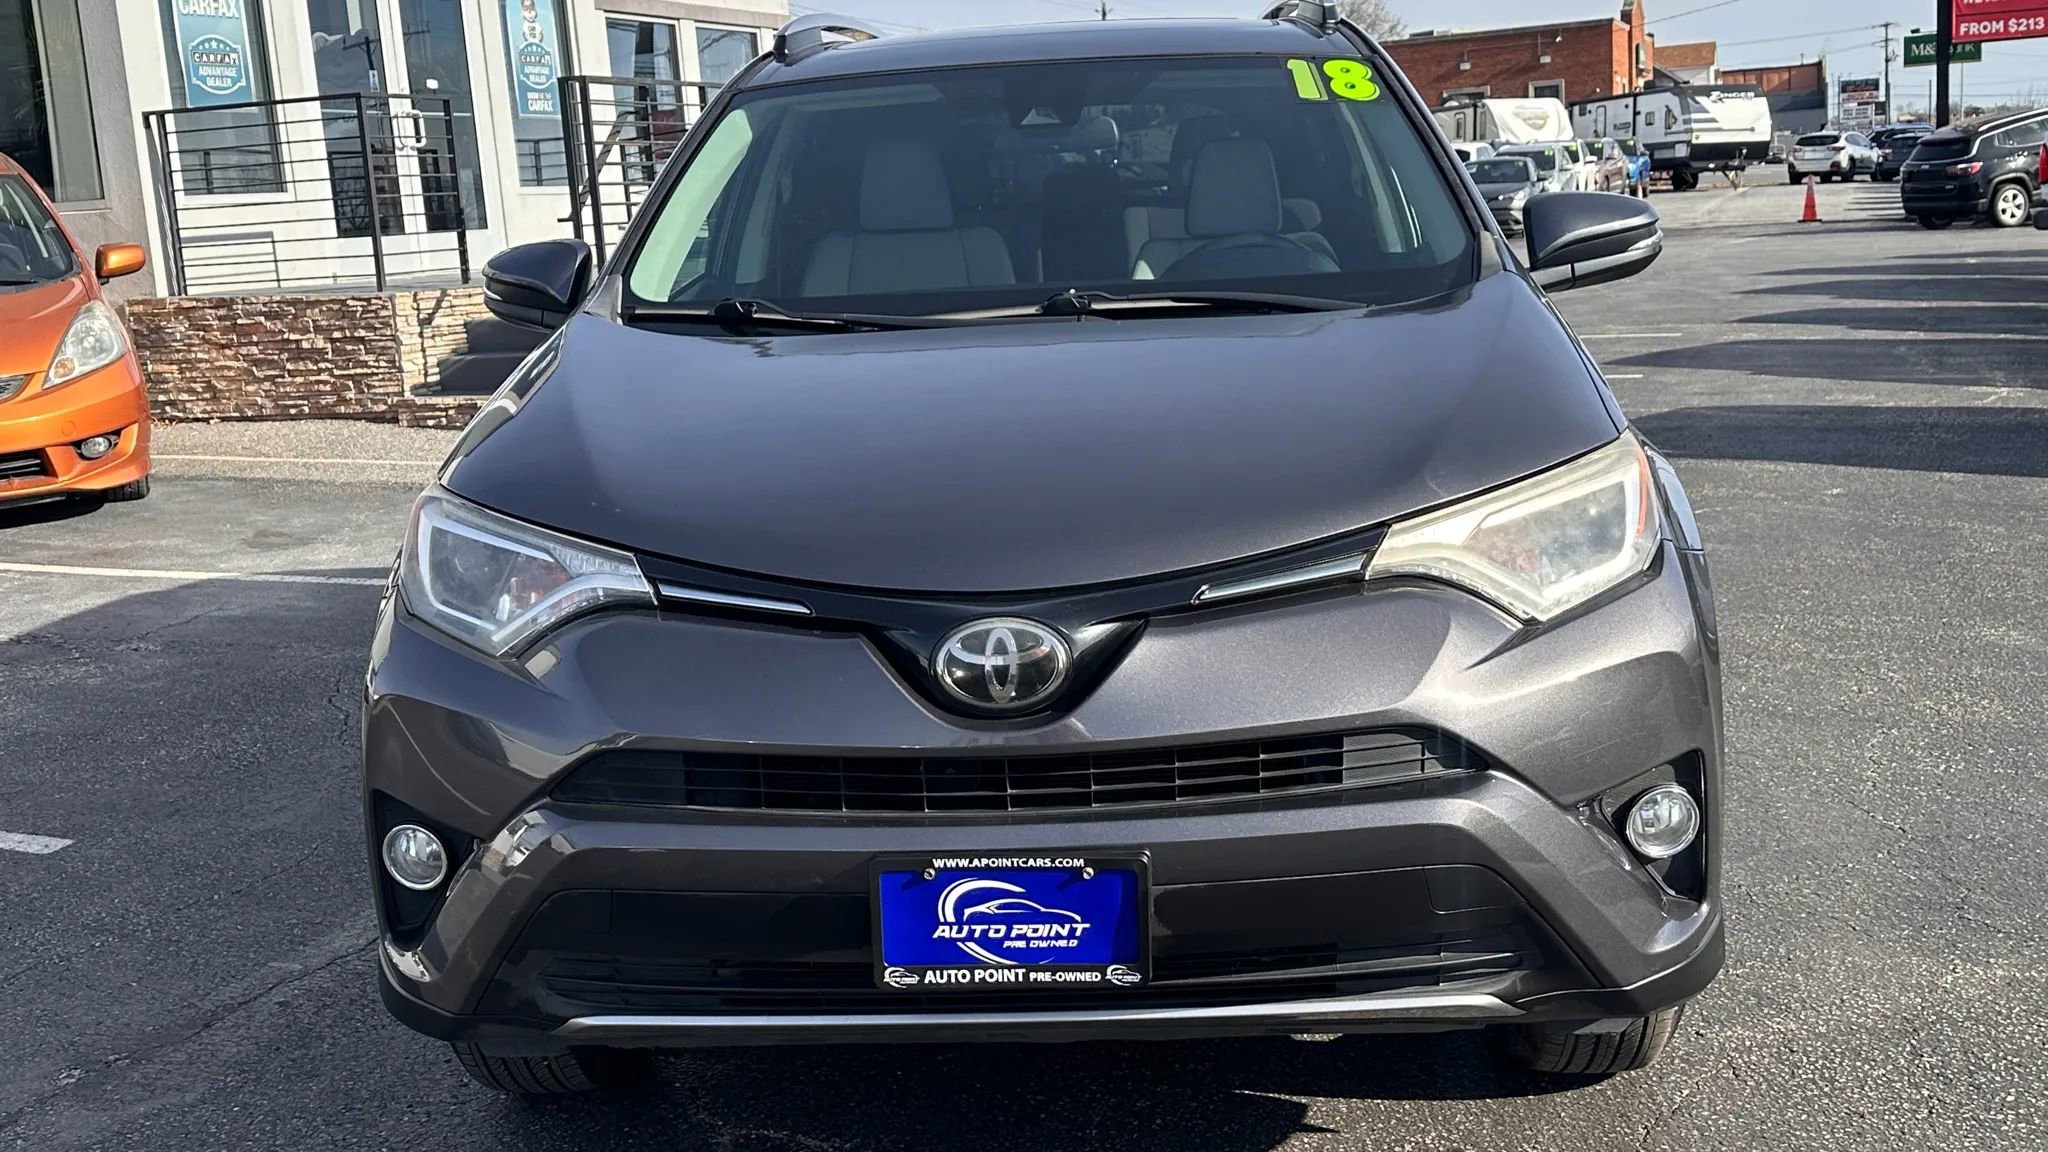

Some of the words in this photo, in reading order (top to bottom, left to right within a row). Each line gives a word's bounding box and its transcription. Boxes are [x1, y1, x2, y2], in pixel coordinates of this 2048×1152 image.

[1960, 20, 2004, 36] FROM
[2008, 16, 2045, 33] $213
[193, 52, 239, 65] CARFAX
[199, 66, 238, 78] ADVANTAGE
[206, 77, 233, 88] DEALER
[1286, 58, 1380, 101] 18
[932, 857, 1085, 868] WWW.APOINTCARS.COM
[932, 923, 1006, 939] AUTO
[1010, 923, 1091, 938] POINT
[1003, 940, 1026, 949] PRE
[1029, 939, 1079, 948] OWNED
[924, 970, 971, 984] AUTO
[975, 968, 1026, 983] POINT
[1029, 971, 1101, 982] PRE-OWNED
